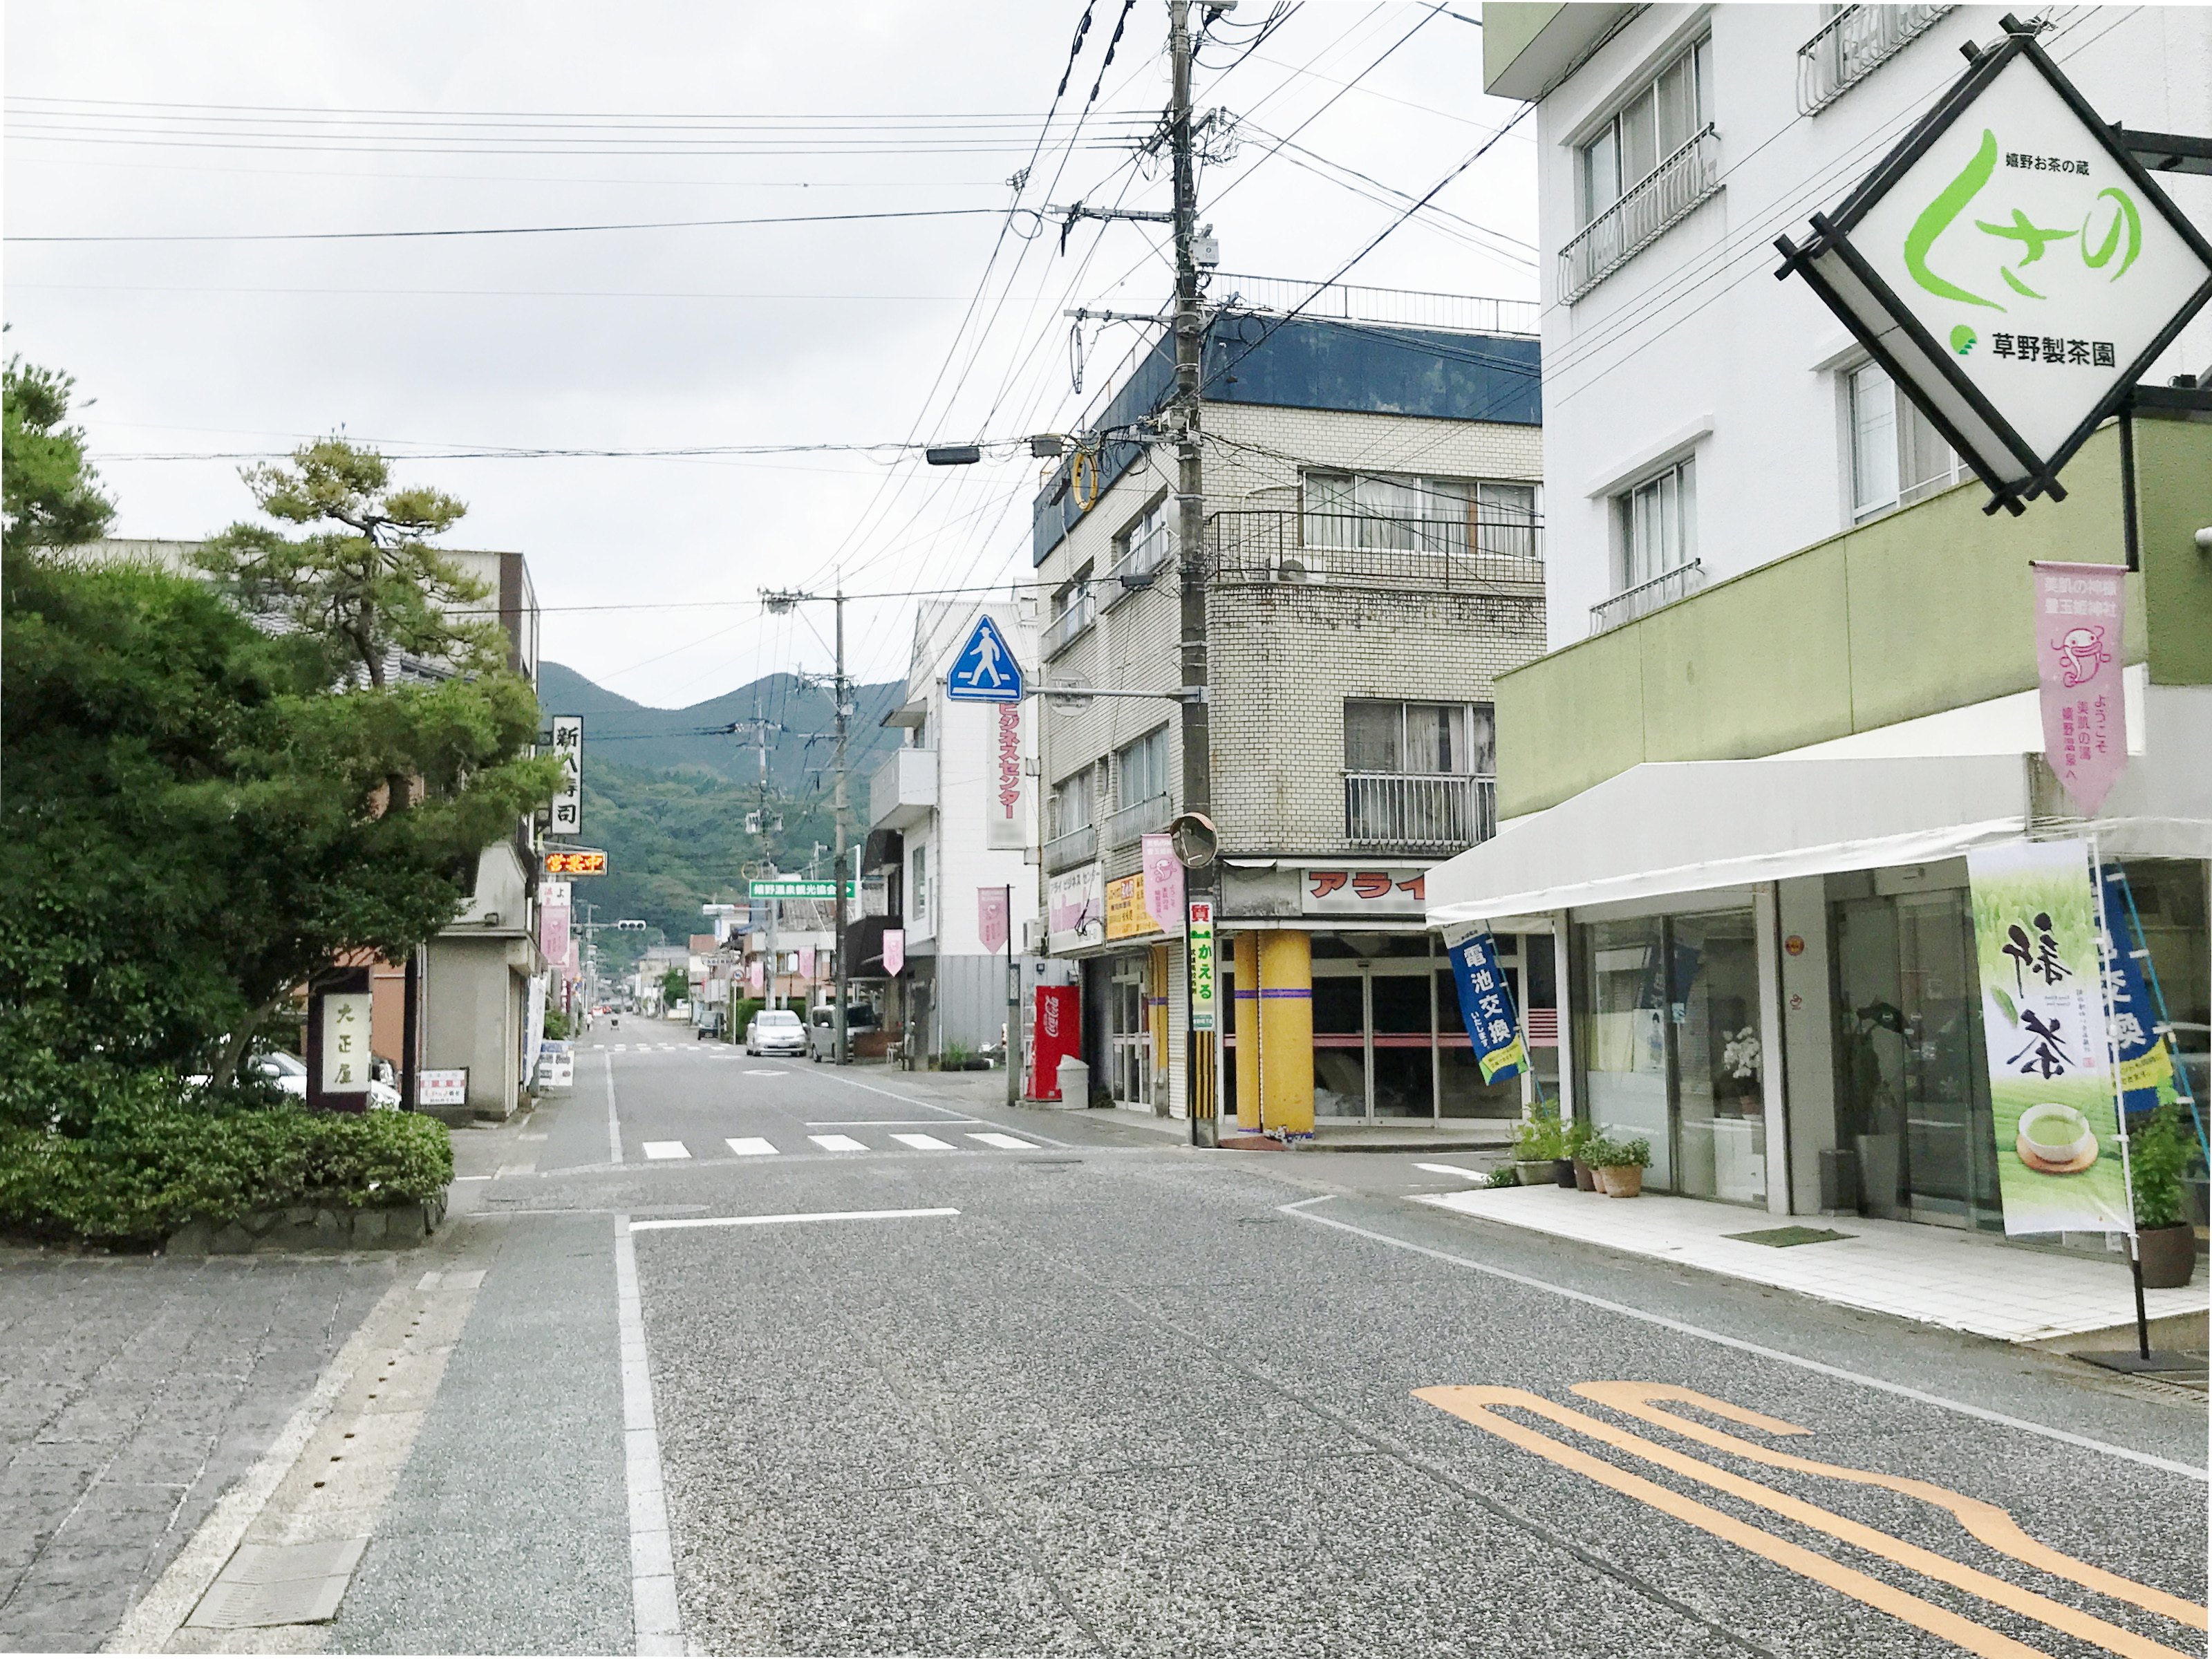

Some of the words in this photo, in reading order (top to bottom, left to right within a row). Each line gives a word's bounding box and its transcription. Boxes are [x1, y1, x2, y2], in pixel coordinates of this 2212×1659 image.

[2005, 152, 2090, 176] 嬉野お茶の蔵
[1904, 128, 2141, 313] くさの
[1992, 332, 2116, 368] 草野製茶園
[2094, 694, 2108, 753] ようこそ
[1191, 904, 1210, 923] 質
[1198, 944, 1212, 1000] かえる
[1463, 944, 1512, 1044] 電池交換
